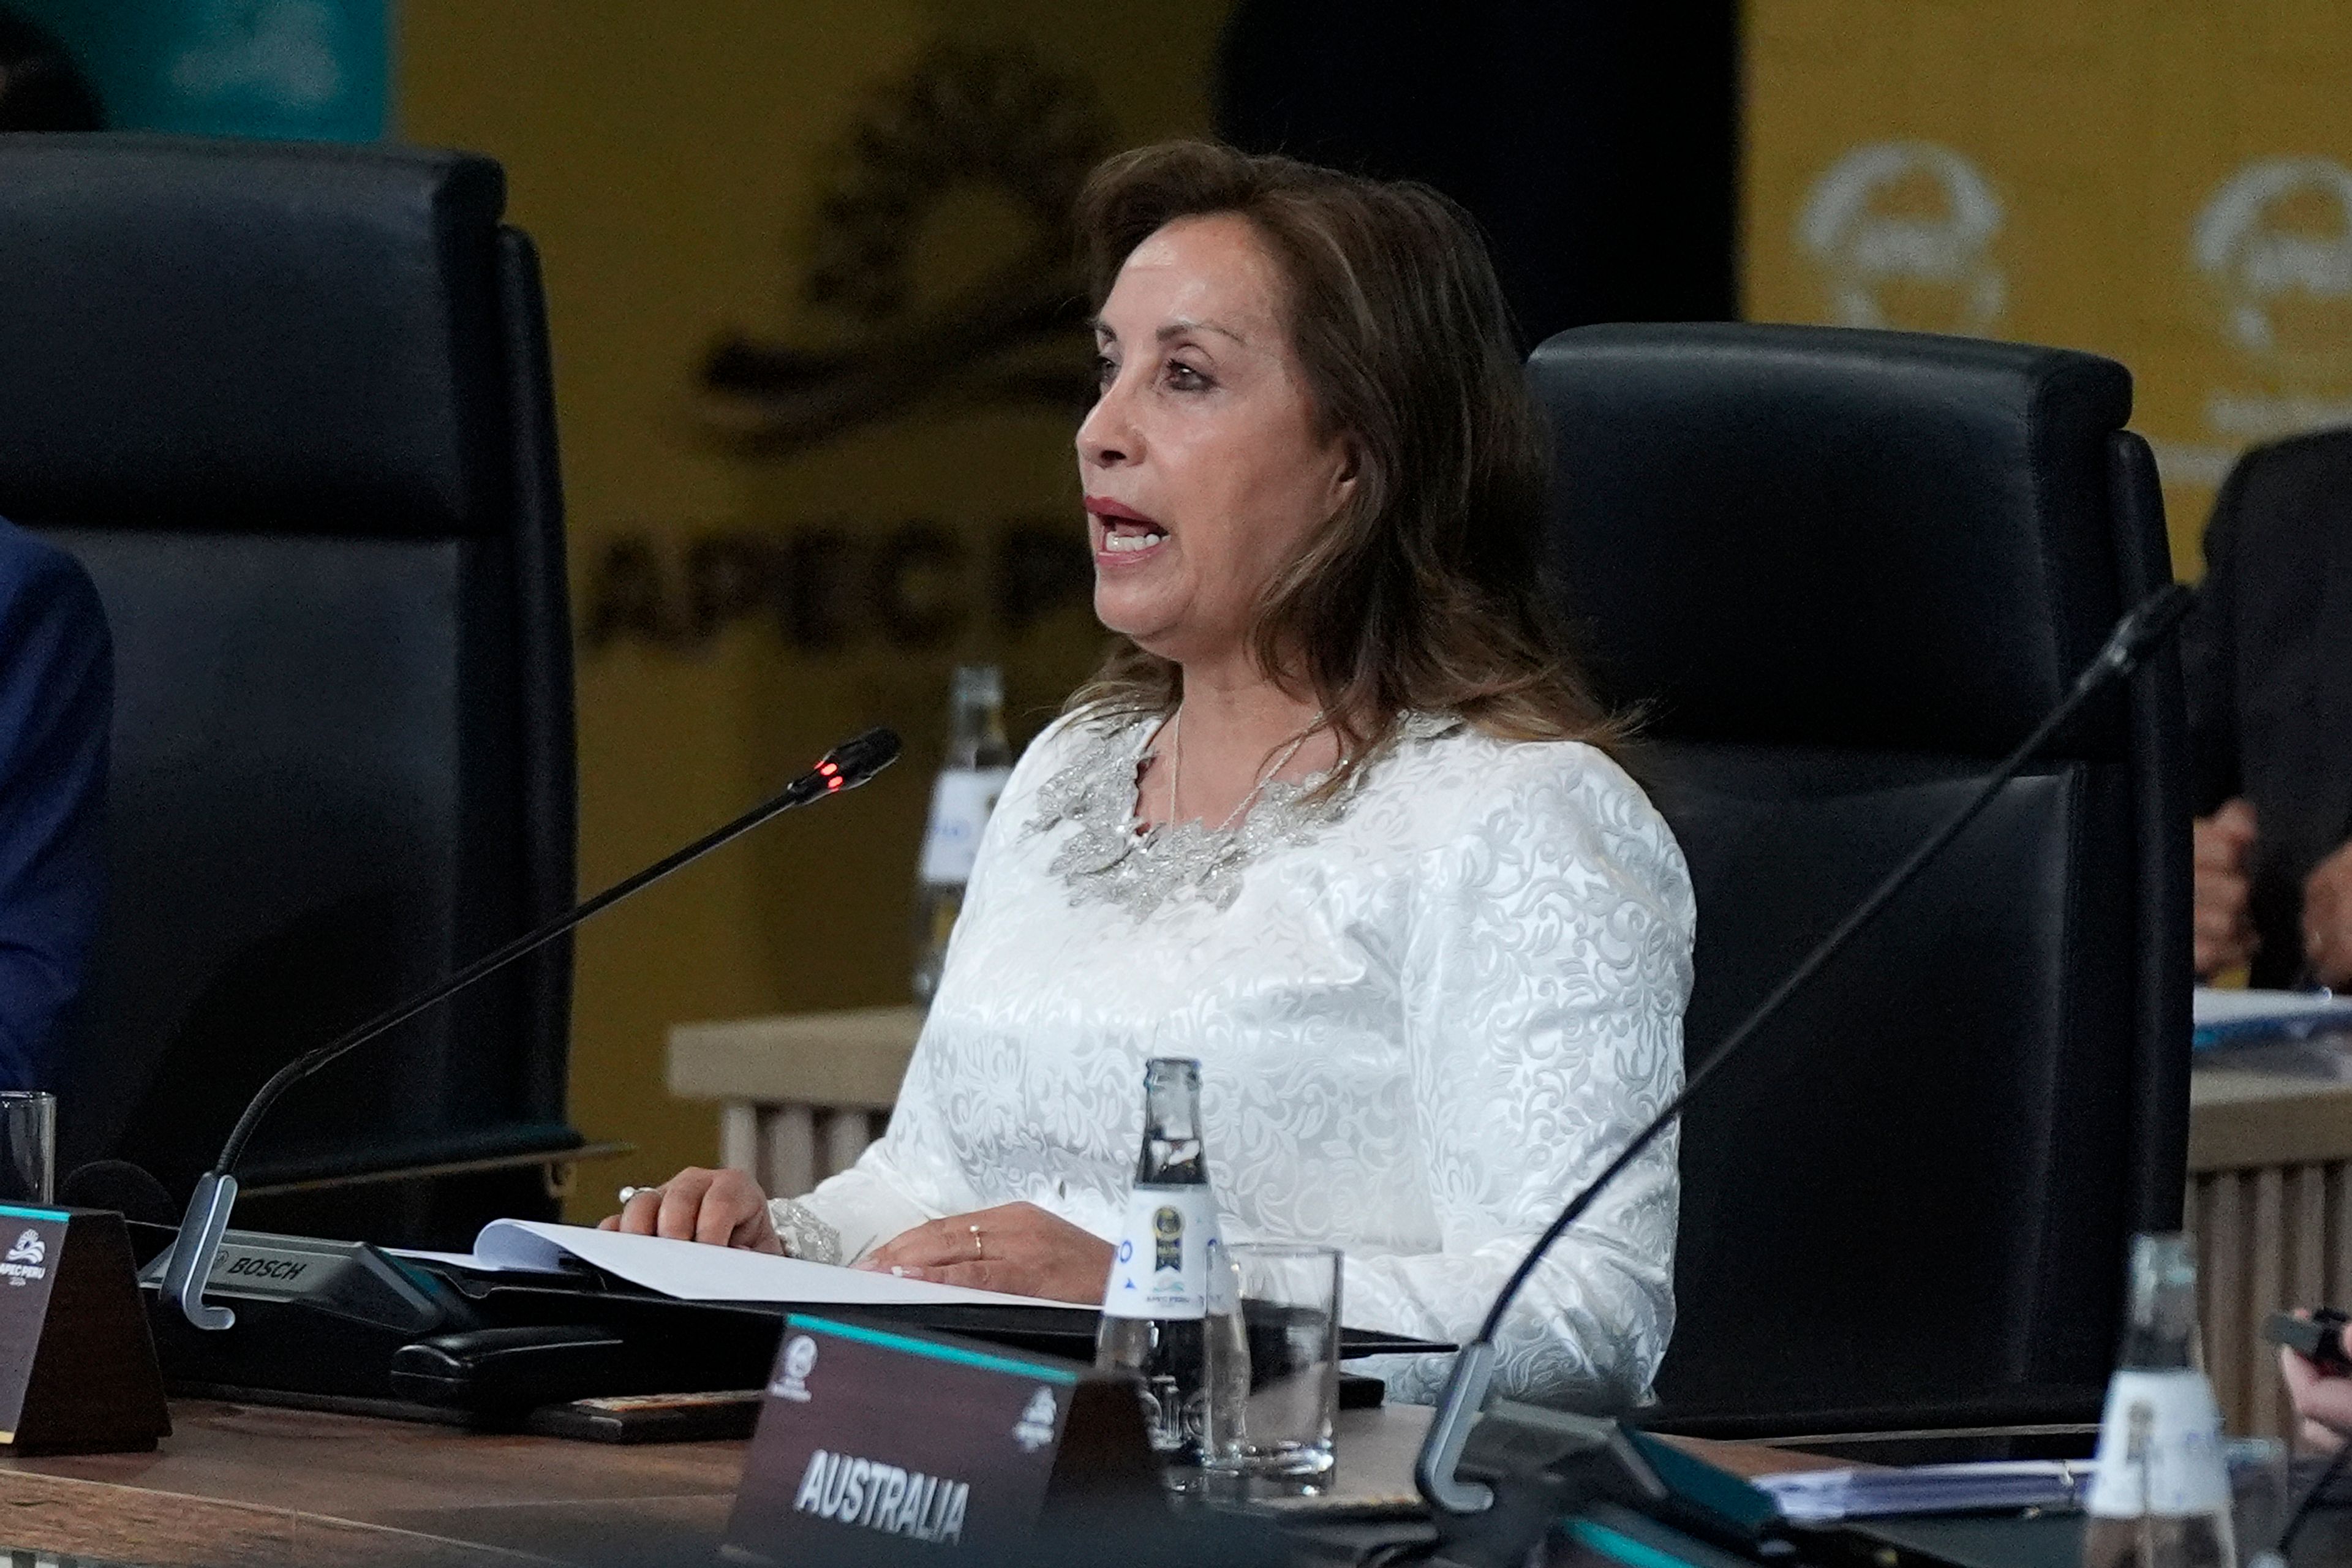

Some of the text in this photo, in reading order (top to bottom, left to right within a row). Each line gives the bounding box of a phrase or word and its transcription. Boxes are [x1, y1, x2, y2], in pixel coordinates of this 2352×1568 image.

[590, 519, 965, 650] APEC
[228, 1257, 307, 1280] BOSCH
[794, 1449, 970, 1546] AUSTRALIA
